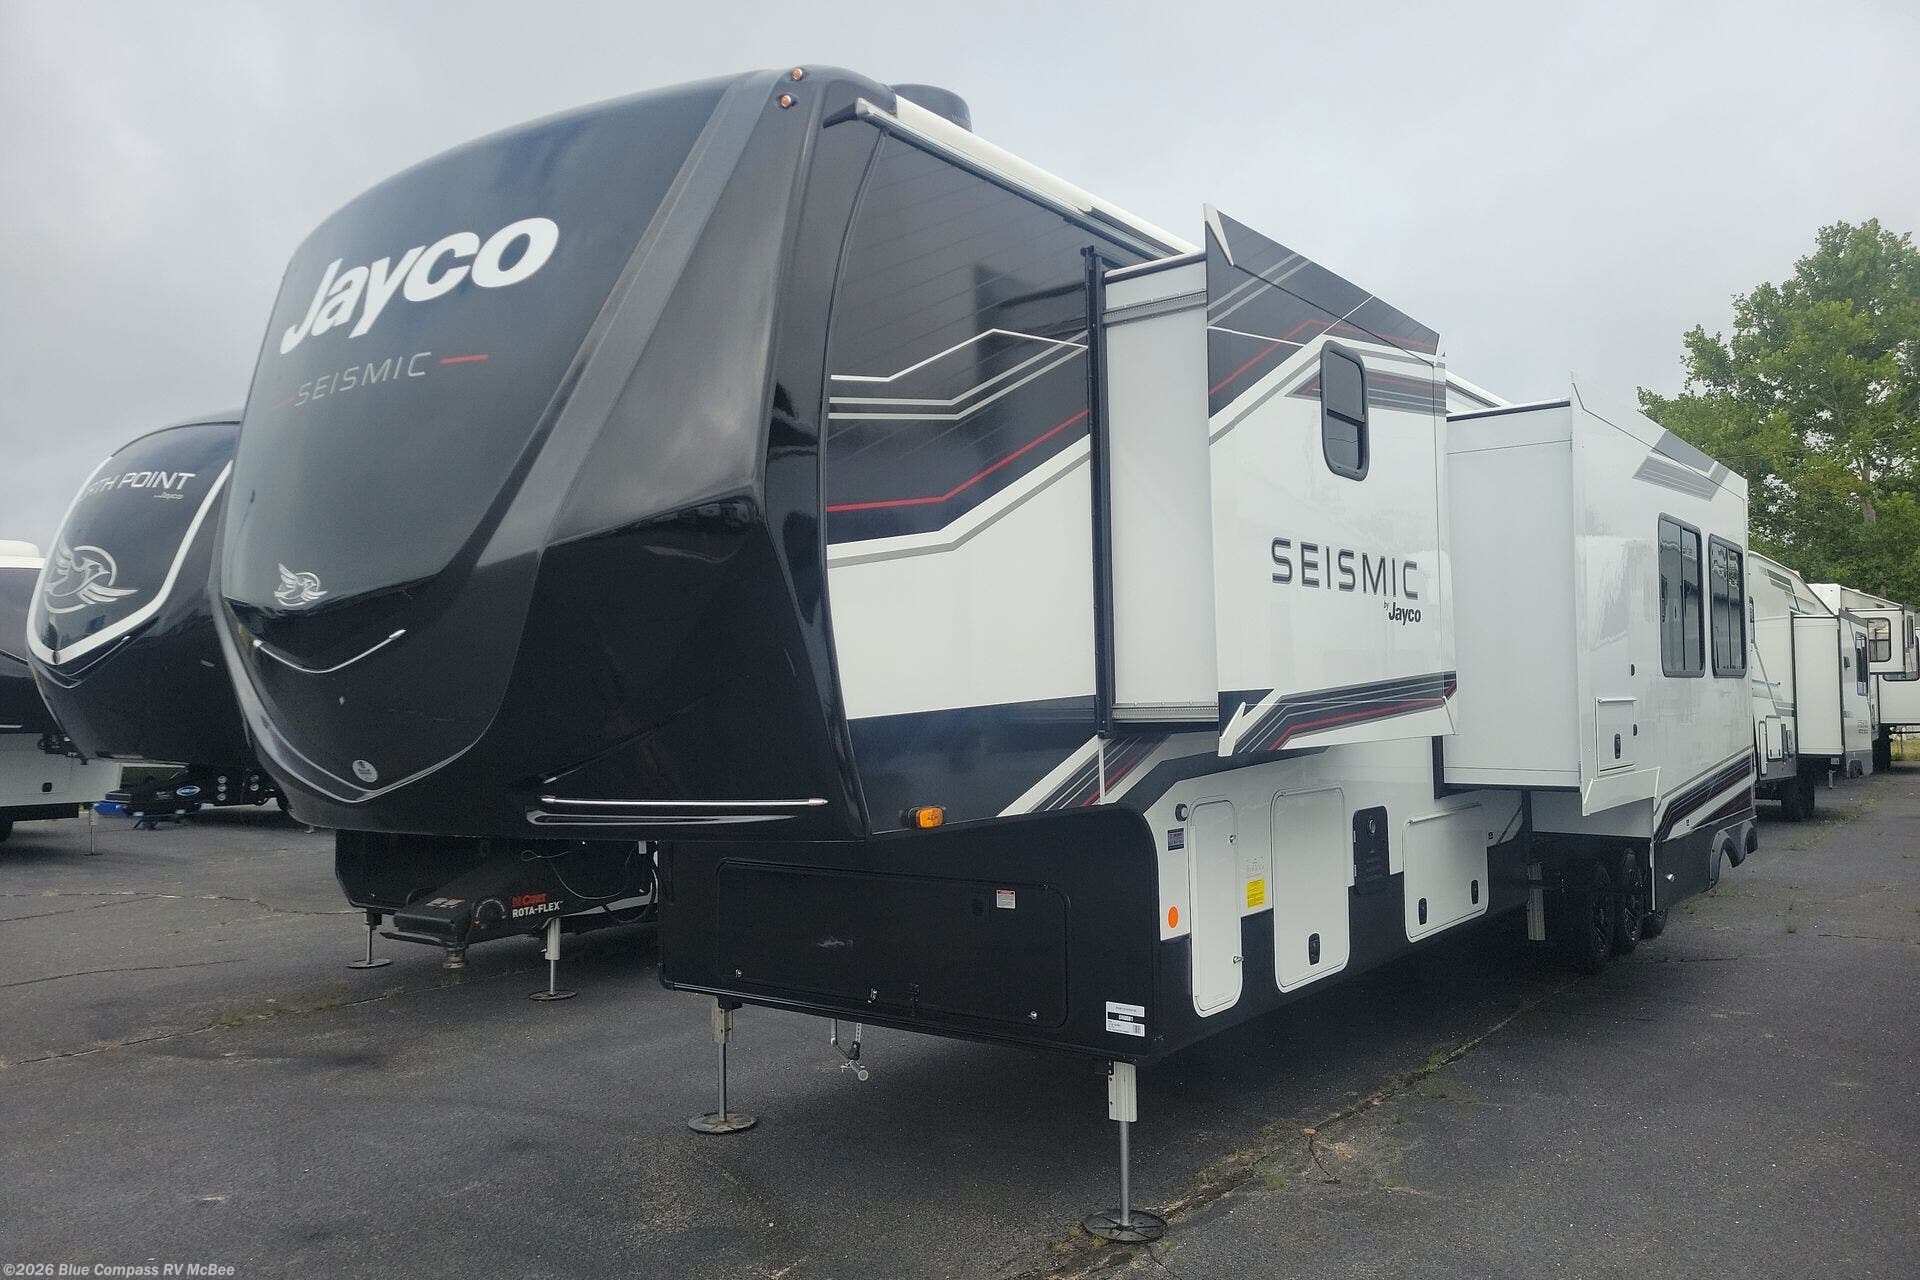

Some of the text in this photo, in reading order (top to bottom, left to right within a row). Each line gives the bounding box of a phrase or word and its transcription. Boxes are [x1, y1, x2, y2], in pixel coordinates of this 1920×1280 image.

[280, 217, 559, 355] Jayco
[294, 351, 432, 408] SEISMIC
[117, 471, 196, 490] POINT
[1271, 536, 1419, 601] SEISMIC
[1388, 601, 1422, 626] Jayco
